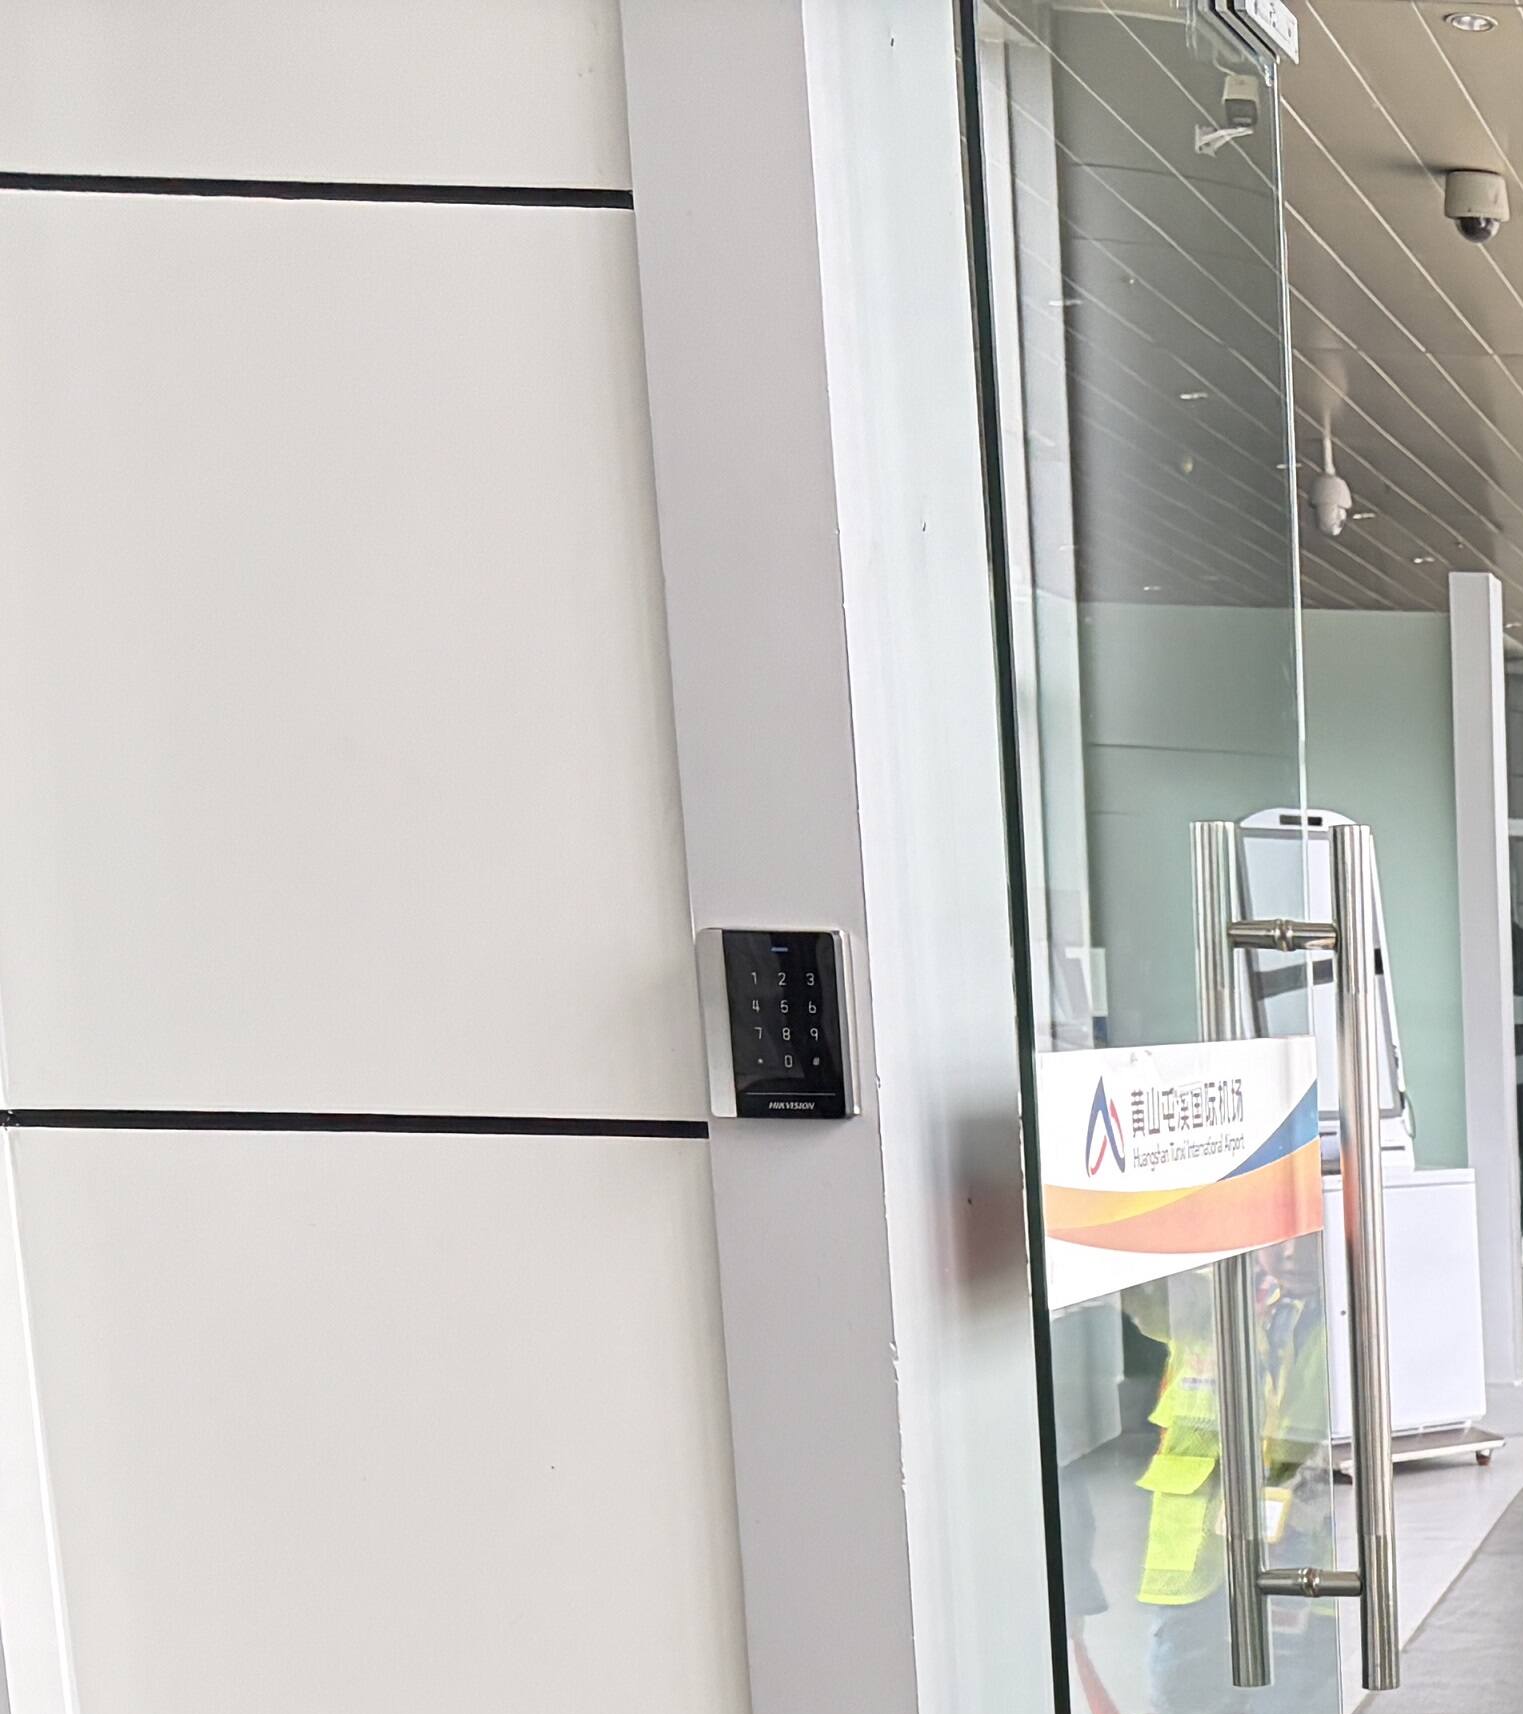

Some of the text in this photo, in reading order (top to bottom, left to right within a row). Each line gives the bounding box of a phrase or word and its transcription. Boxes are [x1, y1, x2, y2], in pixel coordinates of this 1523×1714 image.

[751, 971, 815, 986] 1 2 3
[752, 1000, 760, 1013] 4
[808, 1000, 817, 1014] 6
[754, 1026, 819, 1041] 7 8 9
[784, 1054, 793, 1068] 0
[768, 1101, 815, 1110] HIKVISION
[1131, 1079, 1243, 1138] 黄山屯溪国际机场
